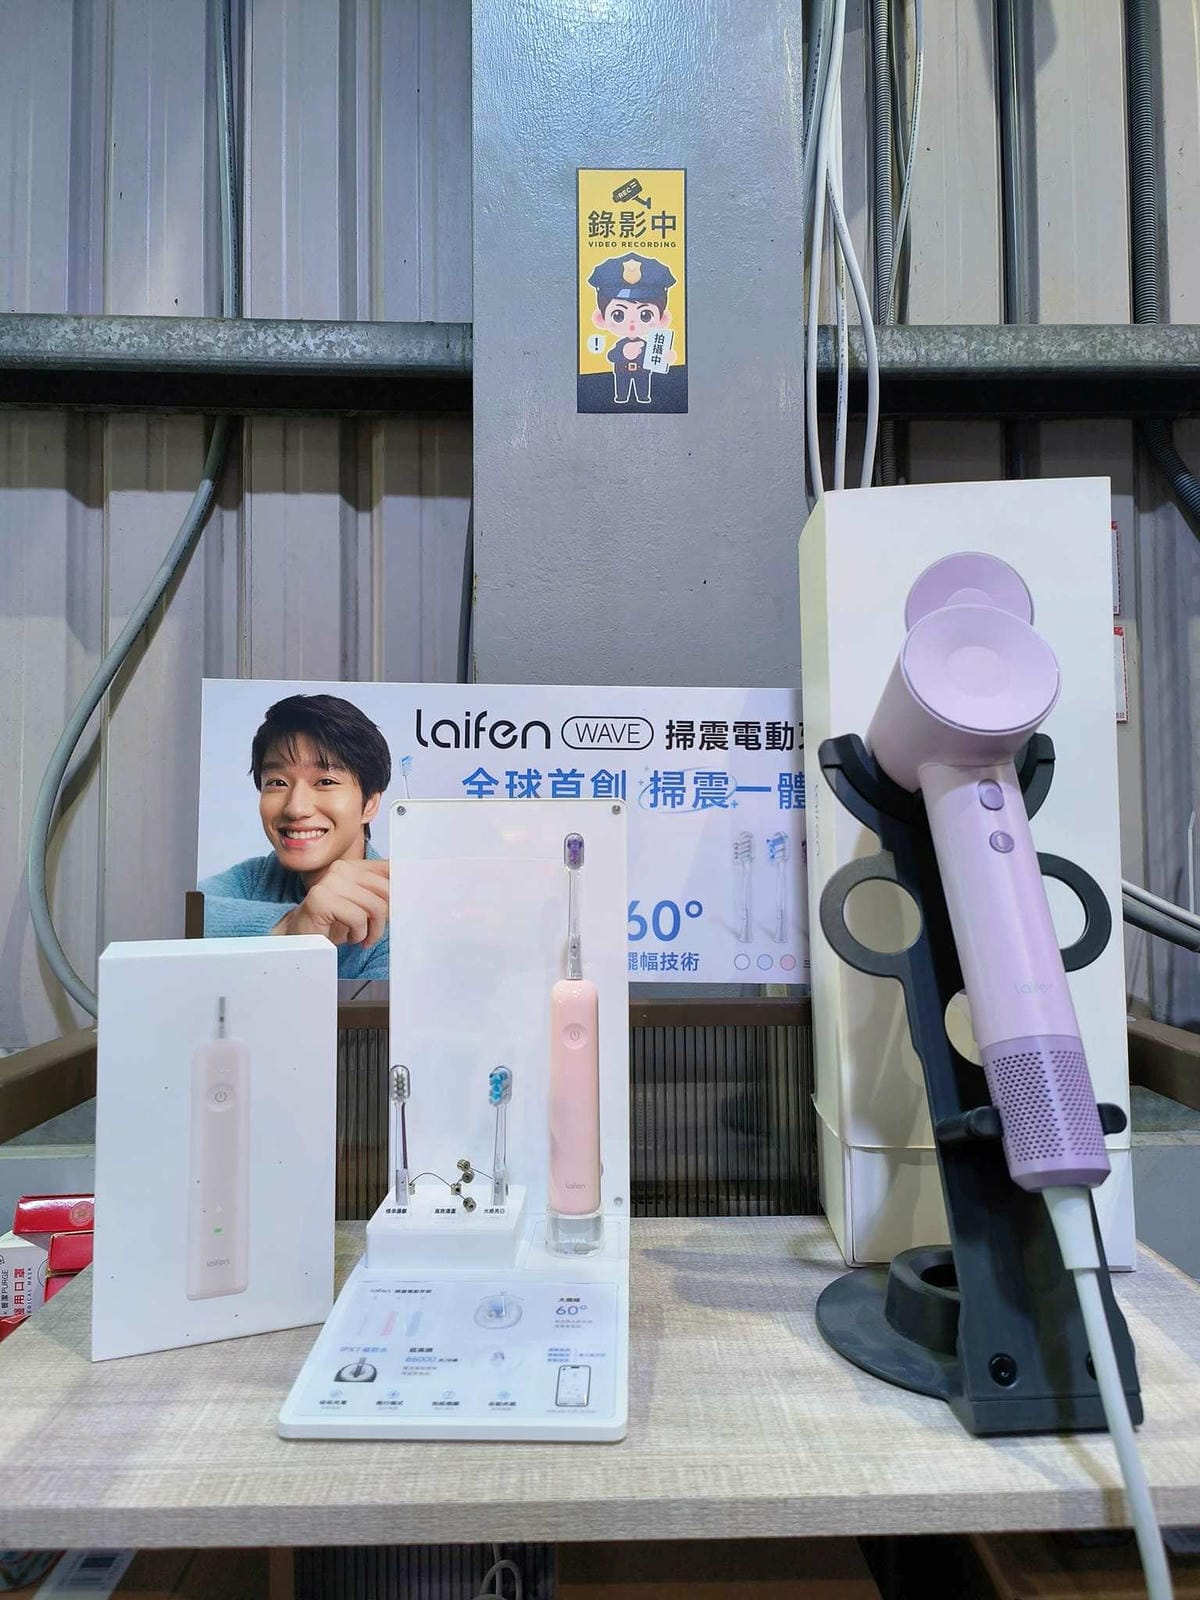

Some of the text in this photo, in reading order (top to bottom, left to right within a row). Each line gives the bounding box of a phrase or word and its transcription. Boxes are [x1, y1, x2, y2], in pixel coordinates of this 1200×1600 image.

[618, 187, 632, 199] REC
[588, 210, 676, 240] 錄影中
[651, 332, 665, 365] 拍攝中
[575, 723, 641, 744] WAVE
[665, 720, 804, 751] 掃震電動
[462, 767, 806, 809] 全球首創 掃震一體
[628, 900, 703, 941] 60°
[556, 1304, 588, 1315] 60°
